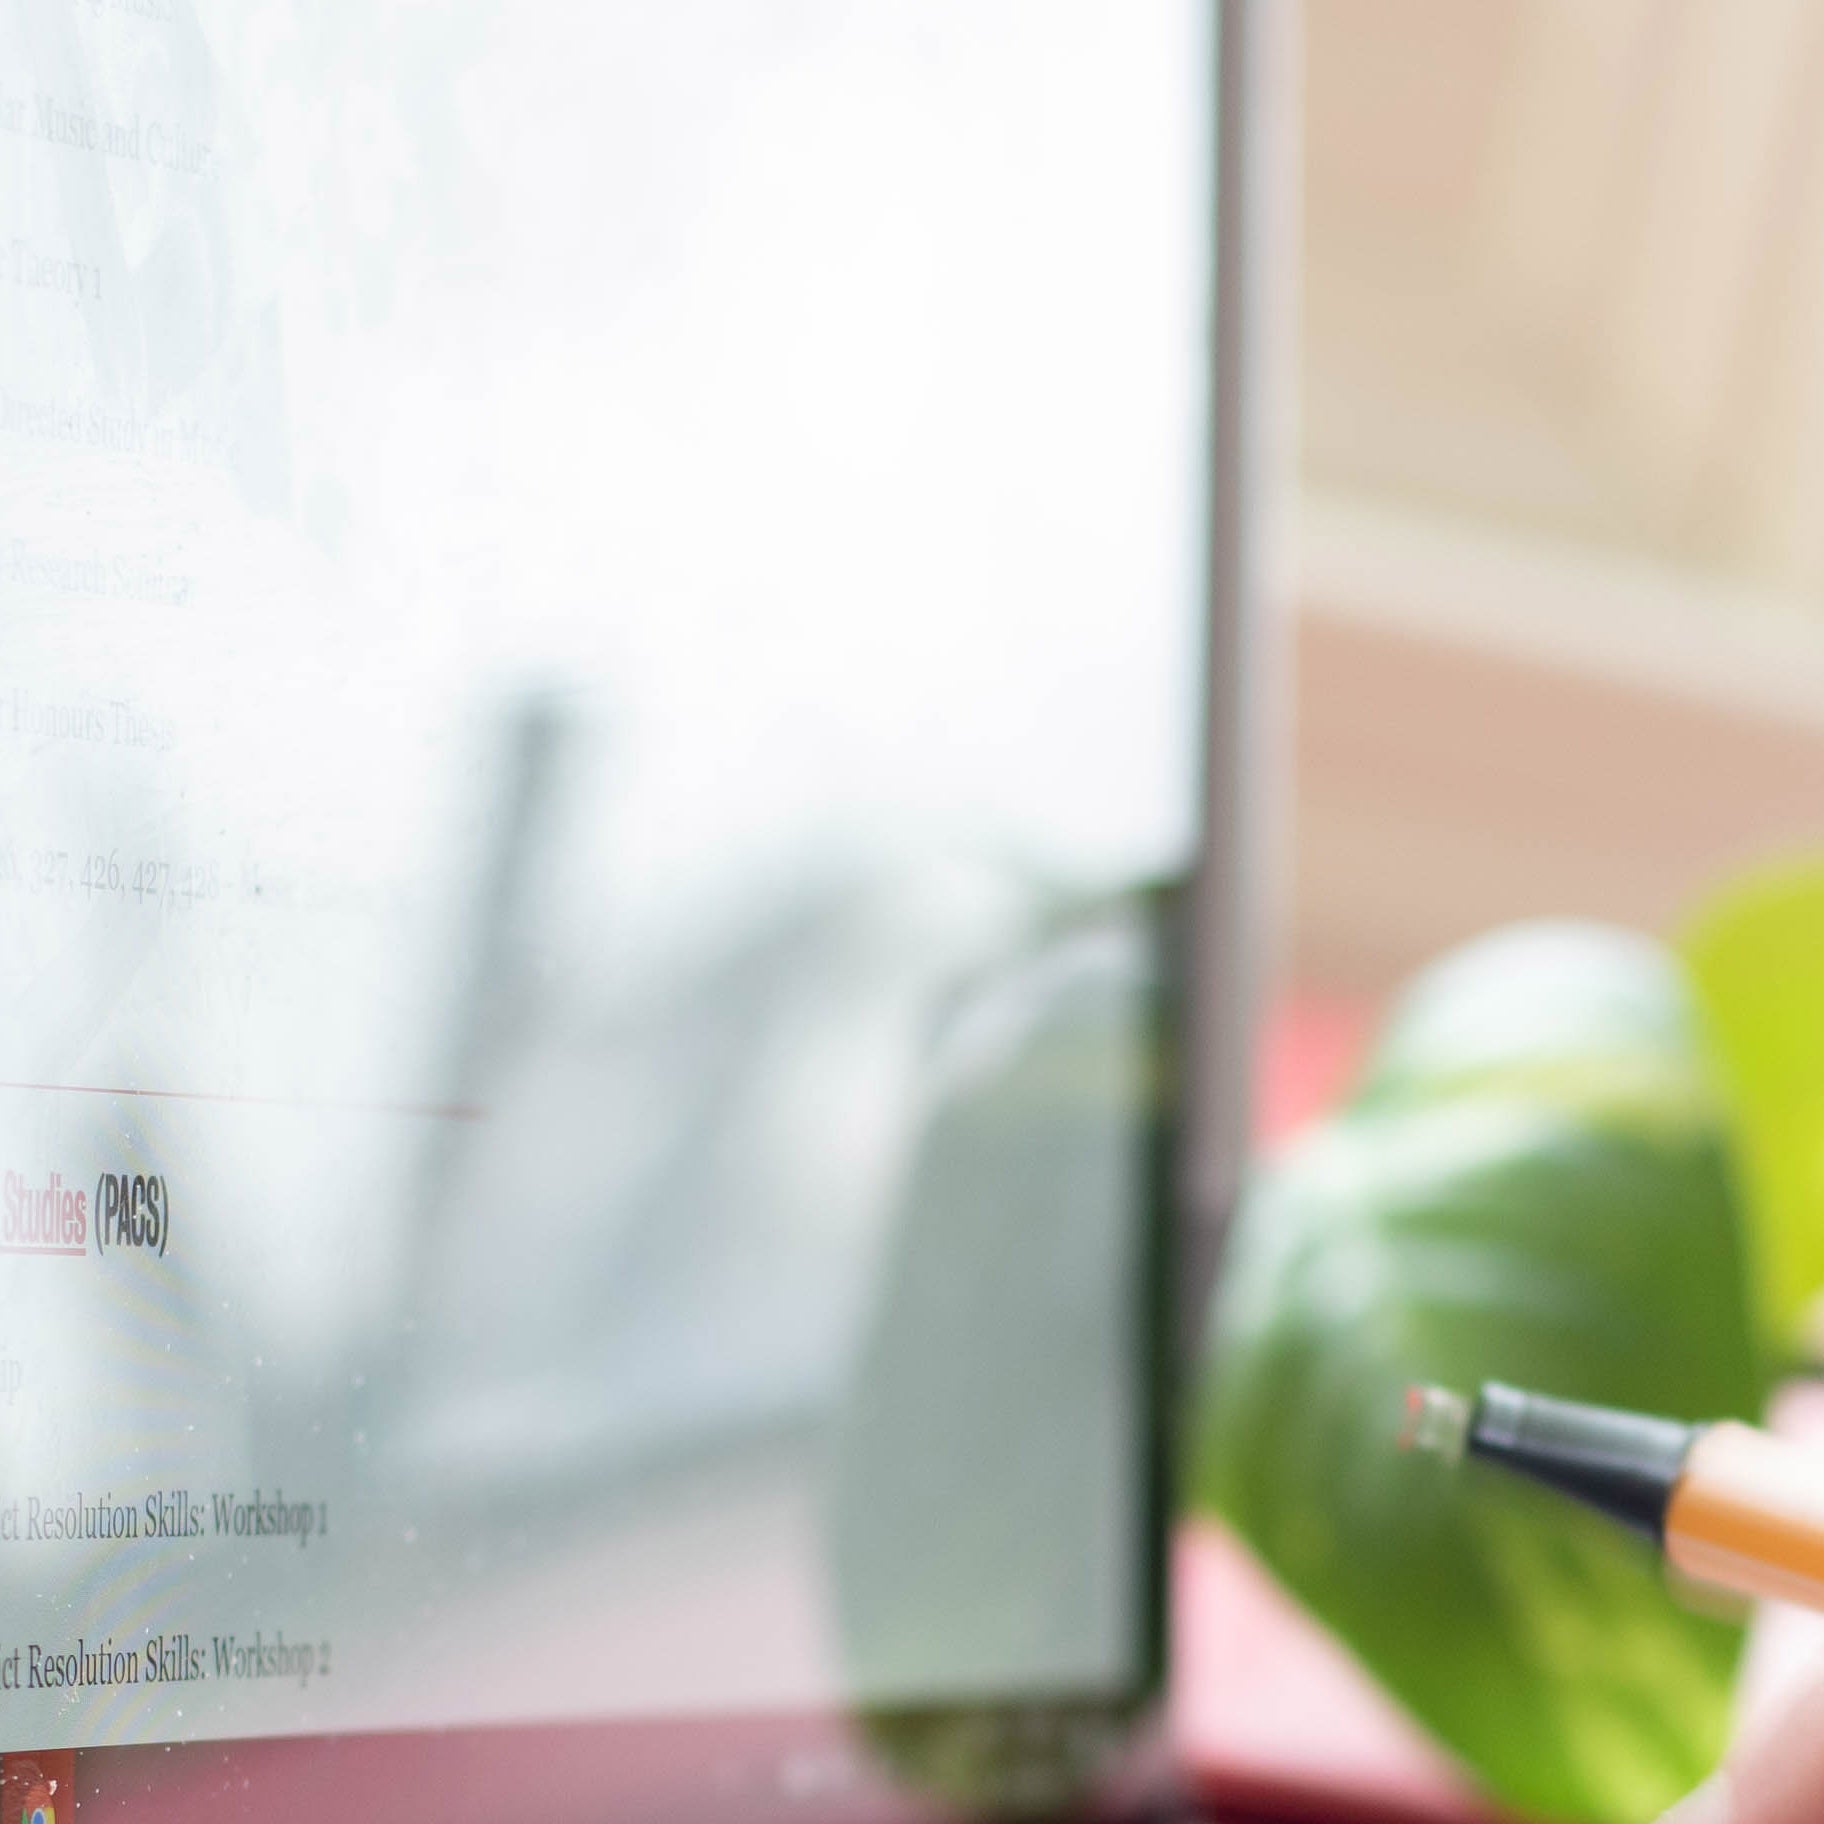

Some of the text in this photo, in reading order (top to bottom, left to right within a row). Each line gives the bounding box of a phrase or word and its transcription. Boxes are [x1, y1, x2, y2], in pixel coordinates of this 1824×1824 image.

[102, 112, 141, 161] and
[11, 686, 177, 751] Honours Thesis
[80, 847, 127, 902] 426,
[4, 1169, 169, 1258] Studies (PACS)
[25, 1492, 138, 1541] Resolution
[144, 1489, 206, 1538] Skills:
[212, 1488, 314, 1548] Workshop
[318, 1500, 328, 1537] 1
[27, 1638, 138, 1689] Resolution
[145, 1634, 206, 1684] Skills:
[212, 1630, 314, 1688] Workshop
[318, 1640, 332, 1677] 2
